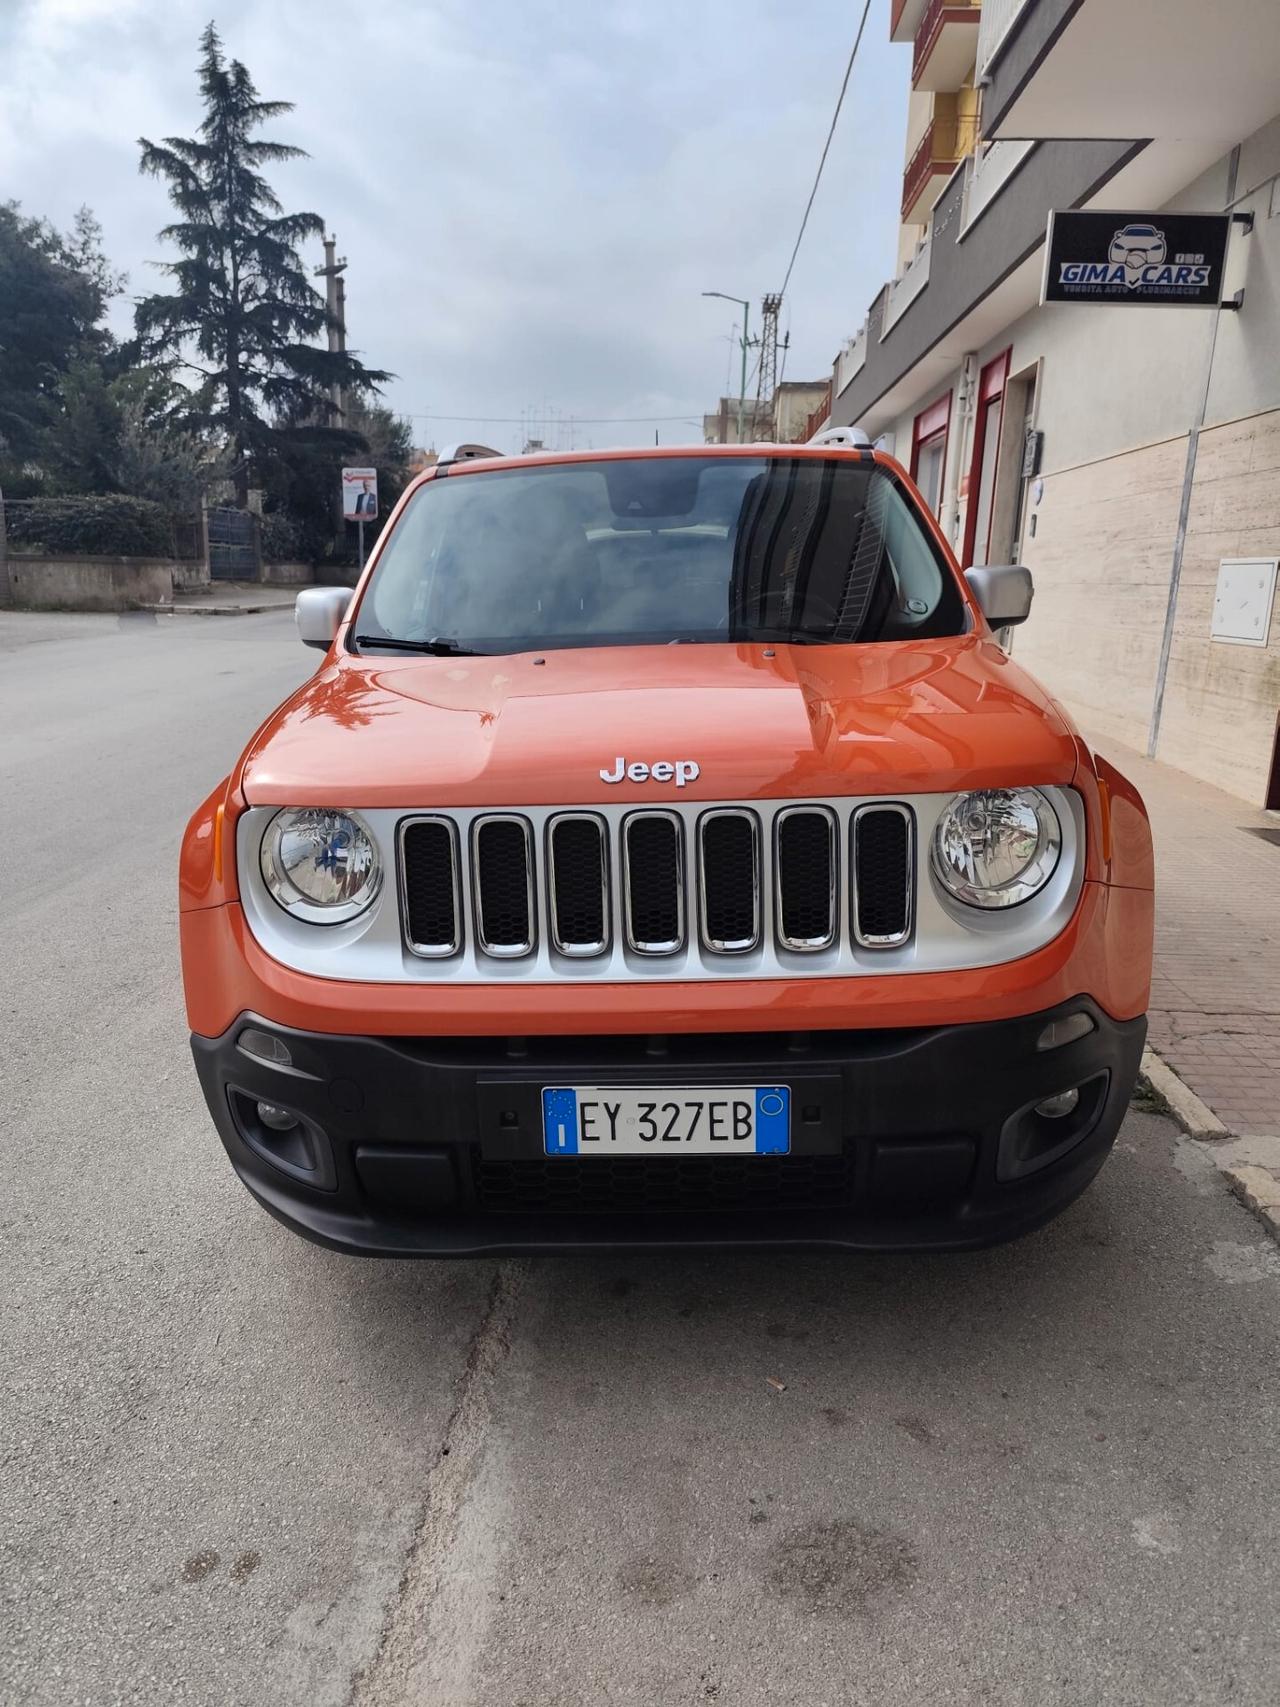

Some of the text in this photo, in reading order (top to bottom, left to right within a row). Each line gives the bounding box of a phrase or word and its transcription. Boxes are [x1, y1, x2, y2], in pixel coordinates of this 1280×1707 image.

[1062, 264, 1209, 285] GIMA CARS
[599, 757, 700, 787] Jeep
[579, 1101, 753, 1142] EY 327EB
